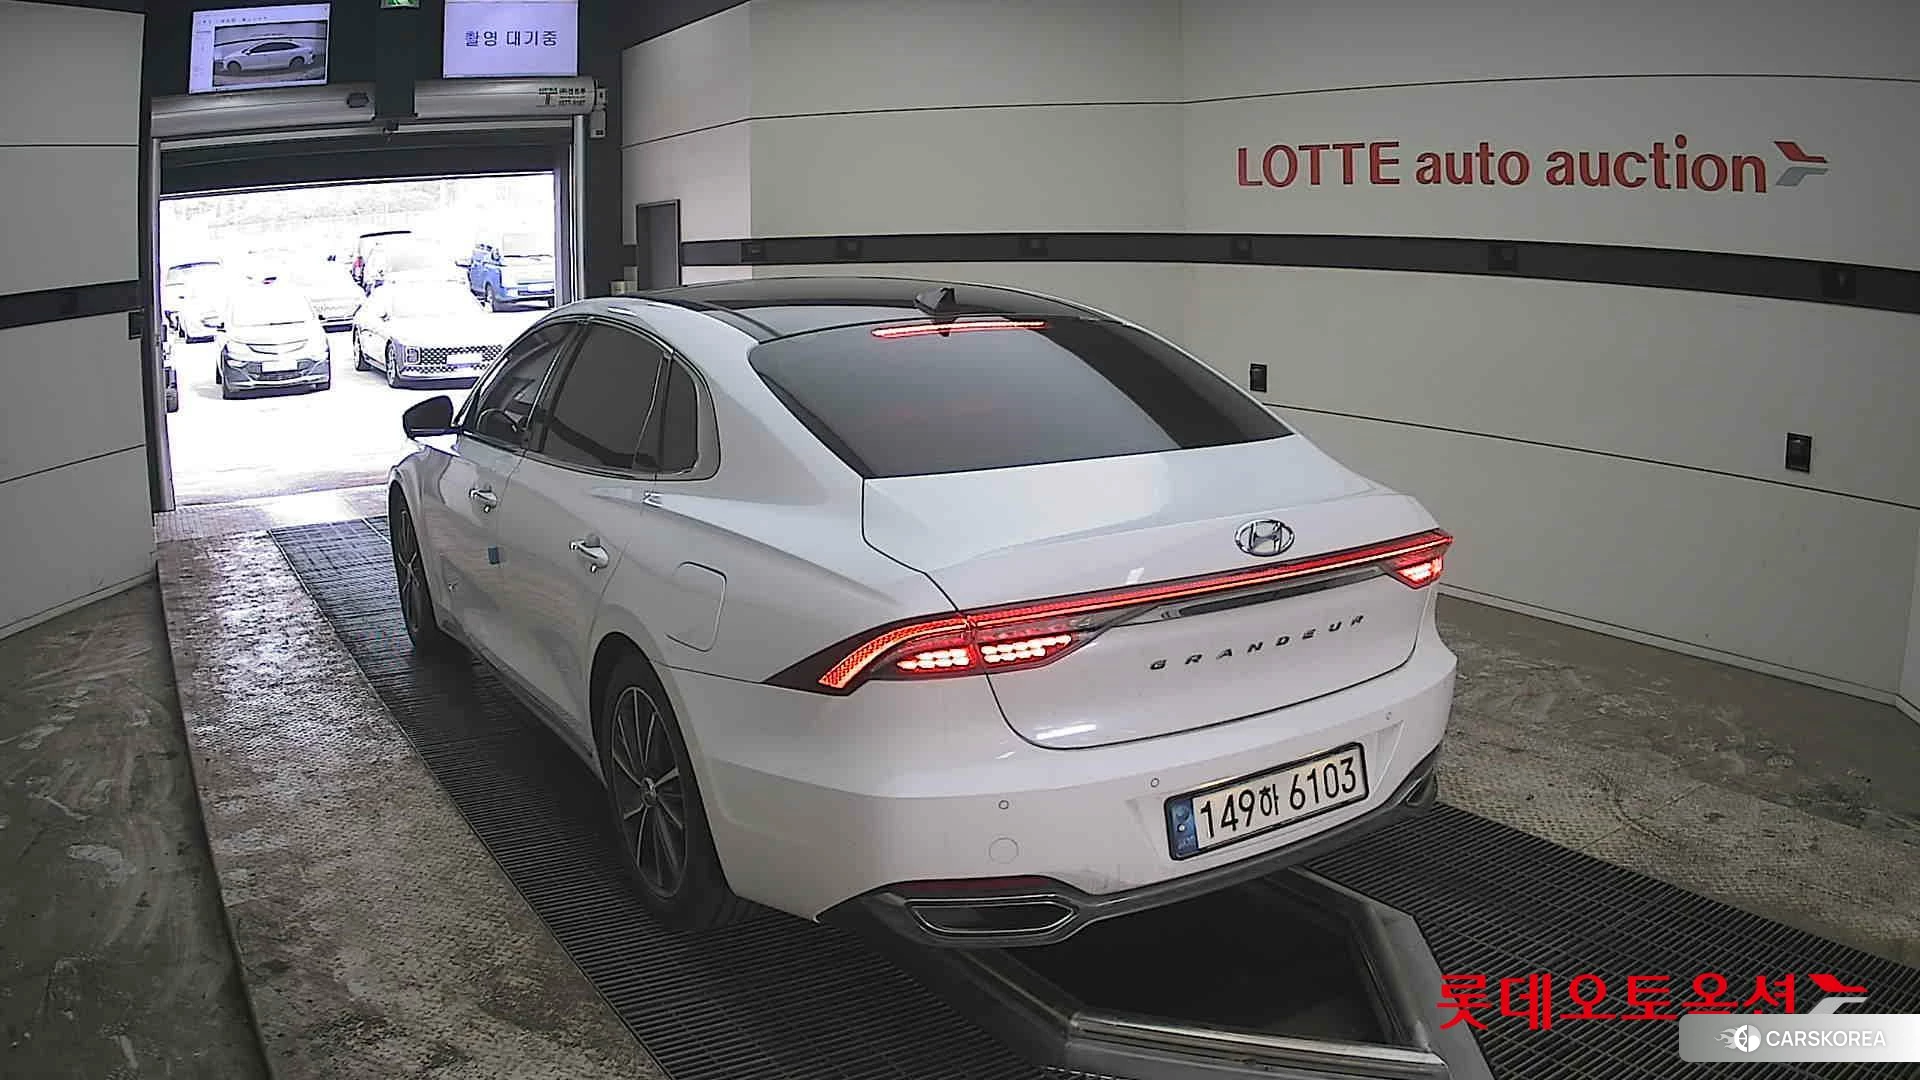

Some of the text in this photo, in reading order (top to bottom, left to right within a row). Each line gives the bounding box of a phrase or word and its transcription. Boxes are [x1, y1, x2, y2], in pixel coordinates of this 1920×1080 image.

[465, 30, 557, 47] 촬영 대기중
[1237, 134, 1767, 194] LOTTE auto auction
[1150, 615, 1364, 670] GRANDEUR
[1200, 757, 1357, 838] 149하 6103
